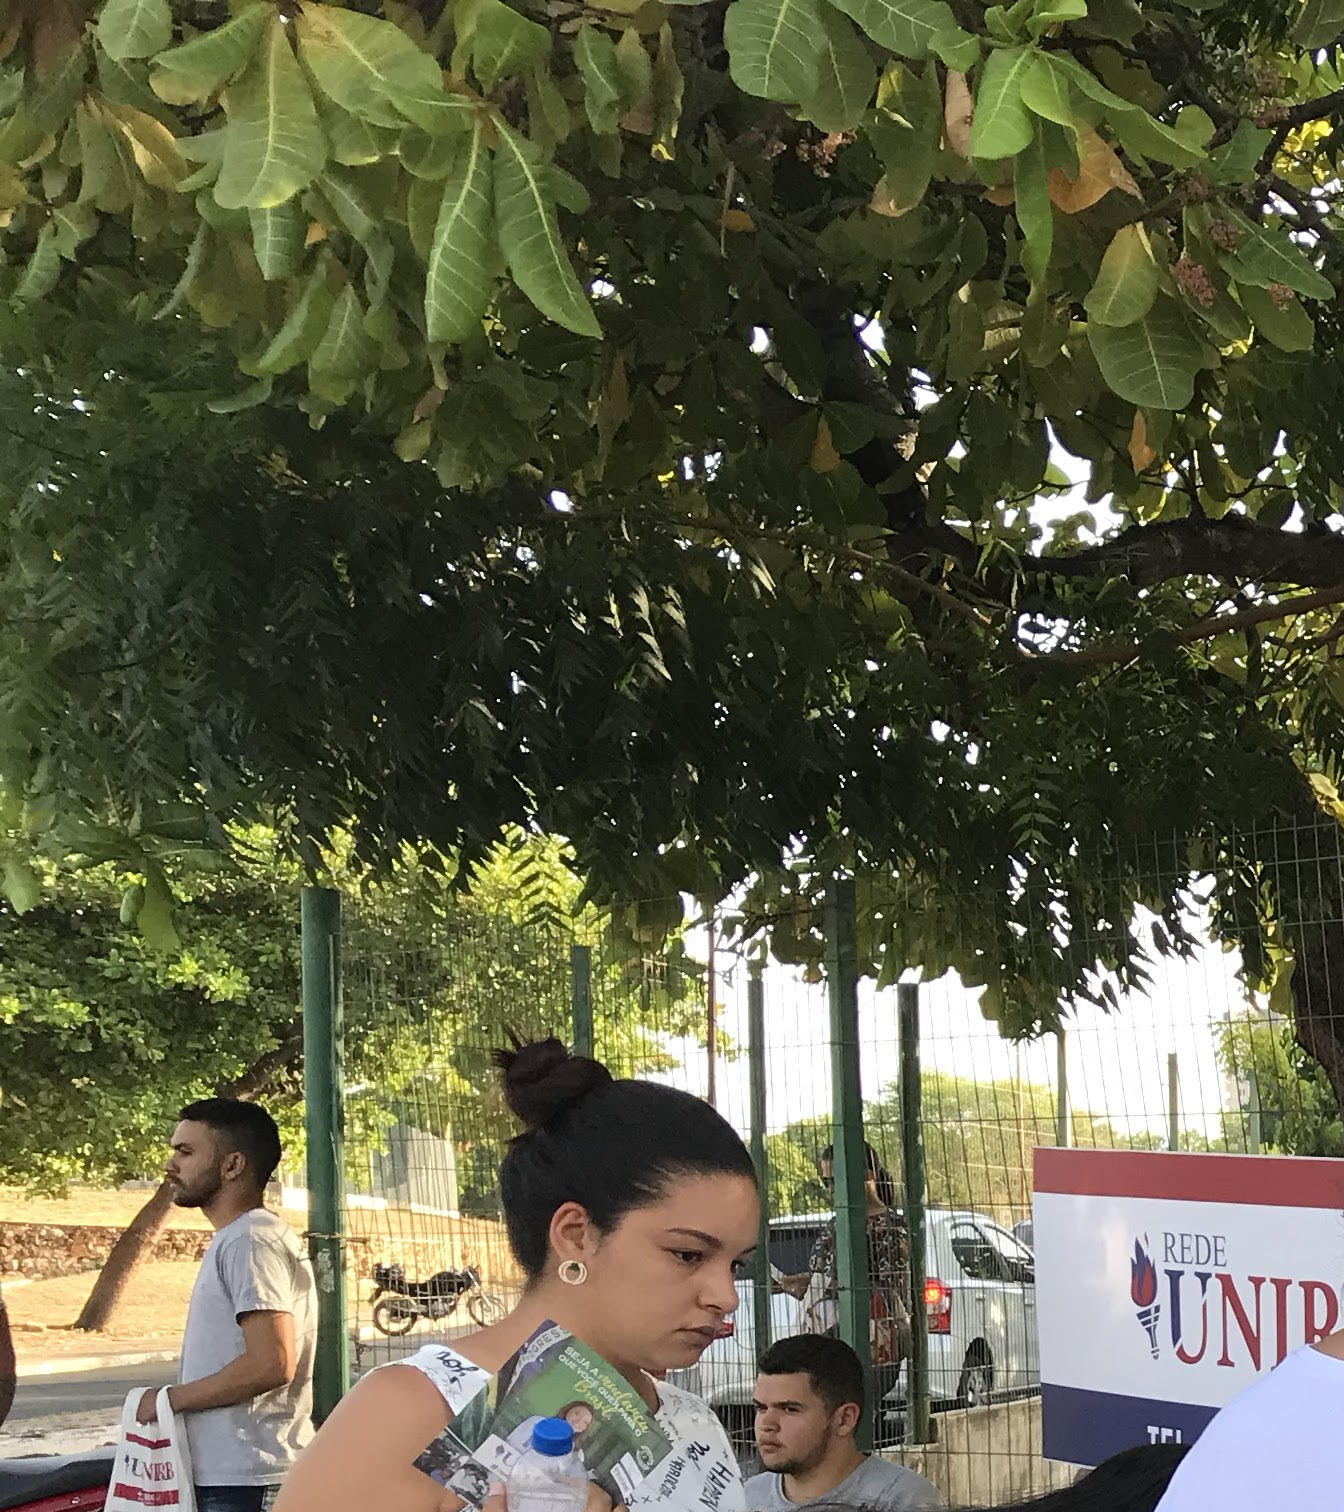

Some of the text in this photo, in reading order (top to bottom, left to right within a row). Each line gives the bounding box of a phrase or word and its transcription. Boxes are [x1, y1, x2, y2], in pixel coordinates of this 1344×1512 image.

[1163, 1231, 1228, 1267] REDE
[558, 1354, 577, 1372] QUE
[564, 1346, 591, 1367] SEJA
